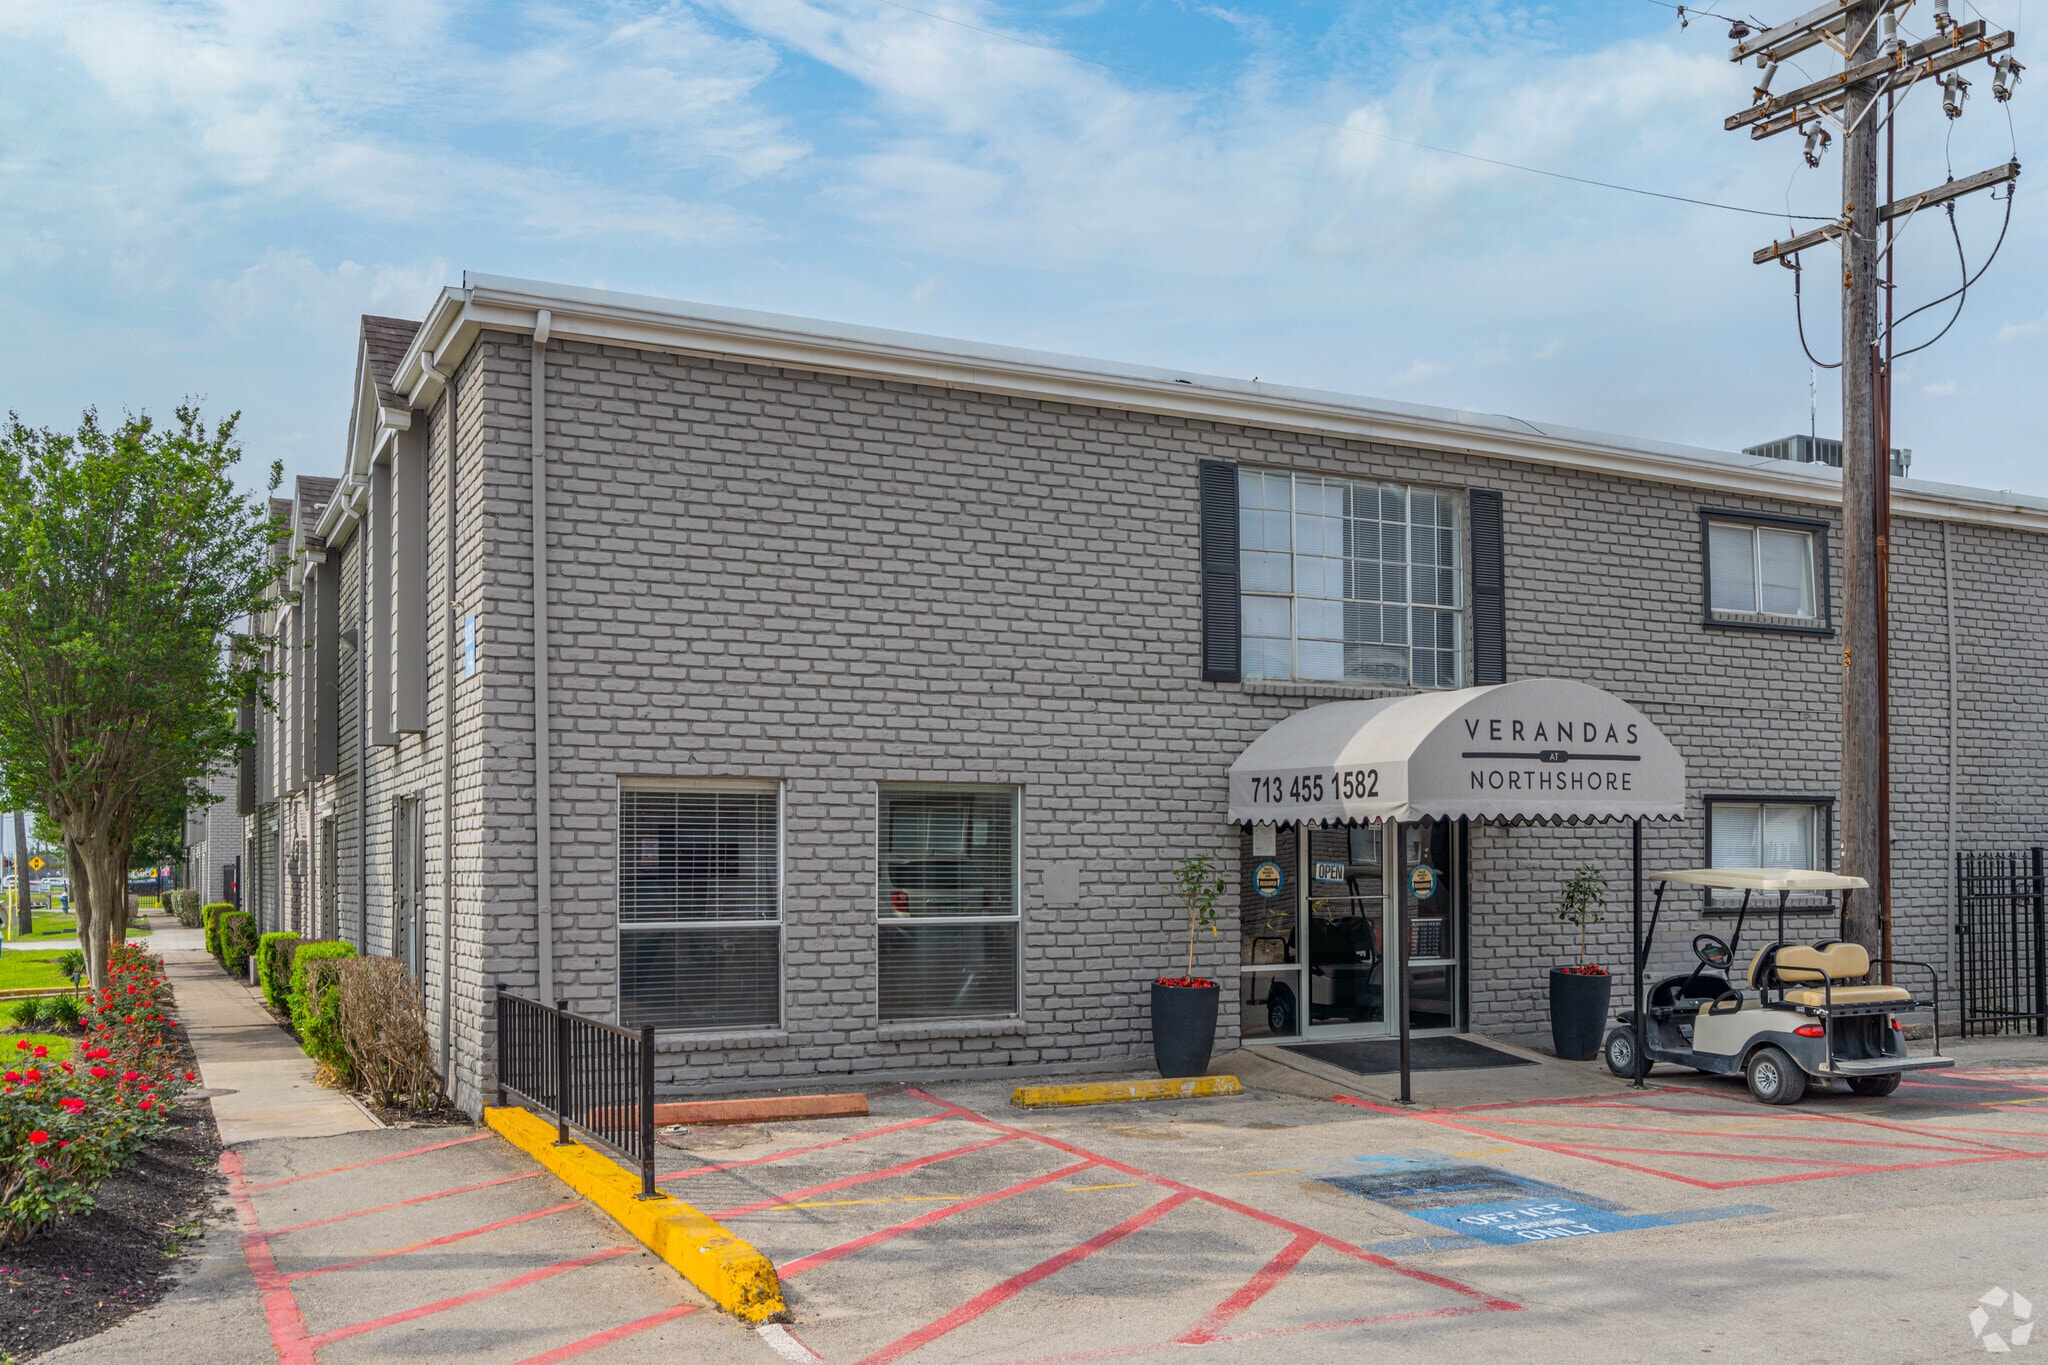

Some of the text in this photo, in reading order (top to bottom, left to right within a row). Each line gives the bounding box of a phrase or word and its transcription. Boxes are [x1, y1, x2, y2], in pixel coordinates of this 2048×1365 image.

[1464, 718, 1639, 744] VERANDAS
[1549, 752, 1560, 762] AT
[1251, 768, 1379, 803] 713 455 1582
[1470, 770, 1632, 791] NORTHSHORE
[1318, 863, 1343, 880] OPEN
[1460, 1203, 1577, 1226] OFFICE
[1516, 1223, 1600, 1240] ONLY
